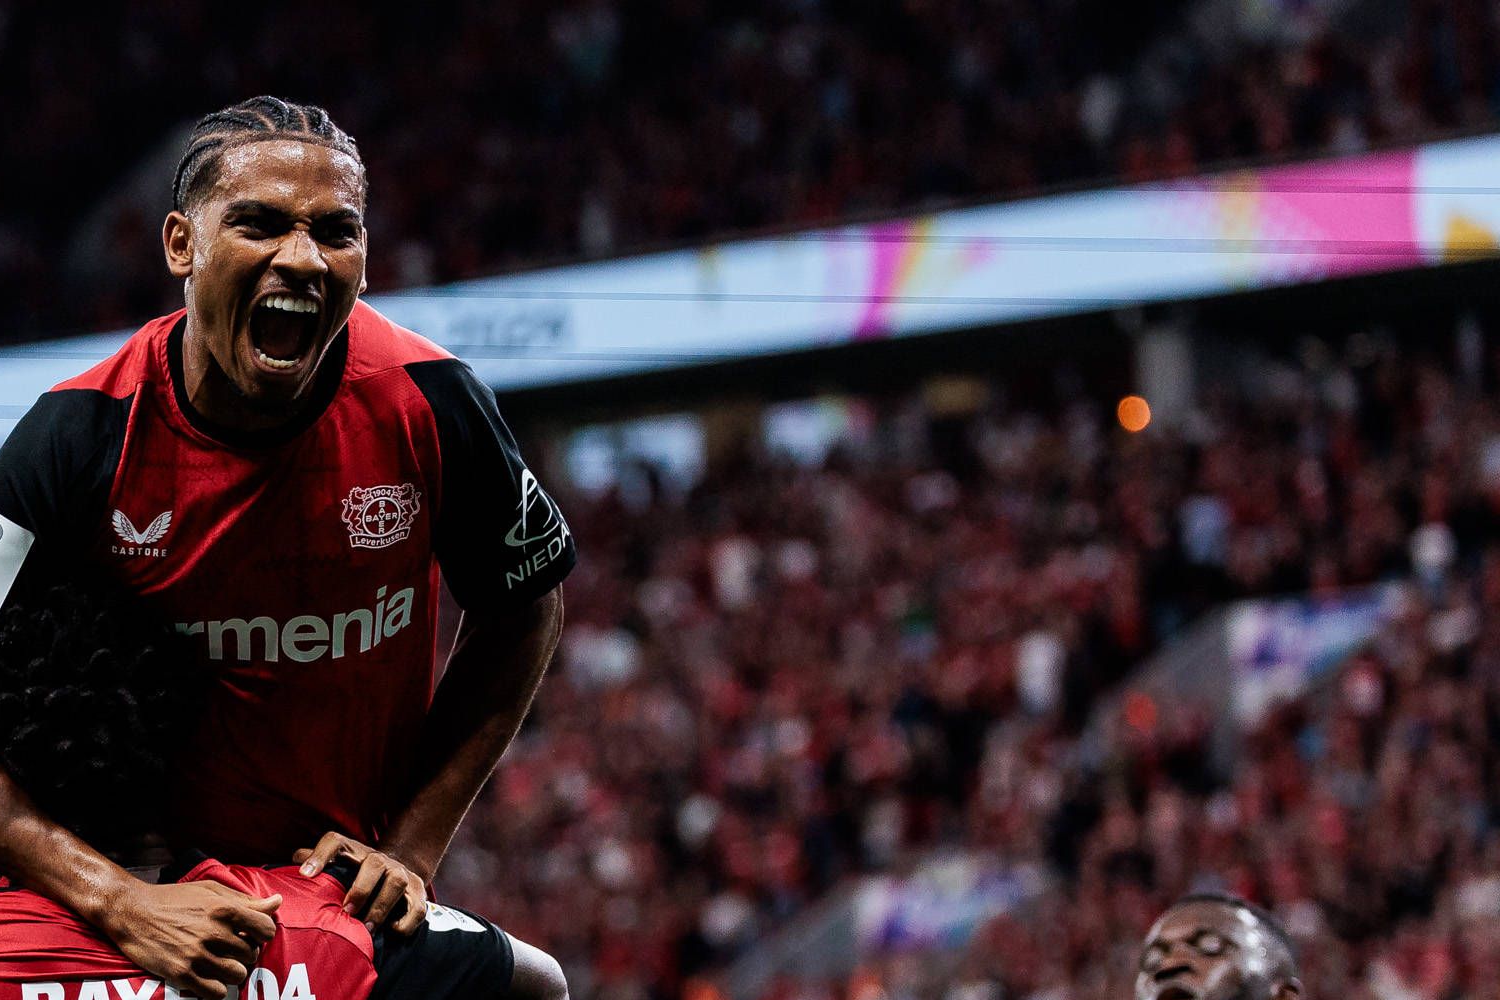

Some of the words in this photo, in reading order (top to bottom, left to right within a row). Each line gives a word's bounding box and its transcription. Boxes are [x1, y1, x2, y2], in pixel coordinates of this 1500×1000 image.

[372, 488, 392, 498] 1904
[365, 511, 398, 523] BAYER
[355, 530, 405, 546] Leverkusen
[111, 545, 168, 558] CASTORE
